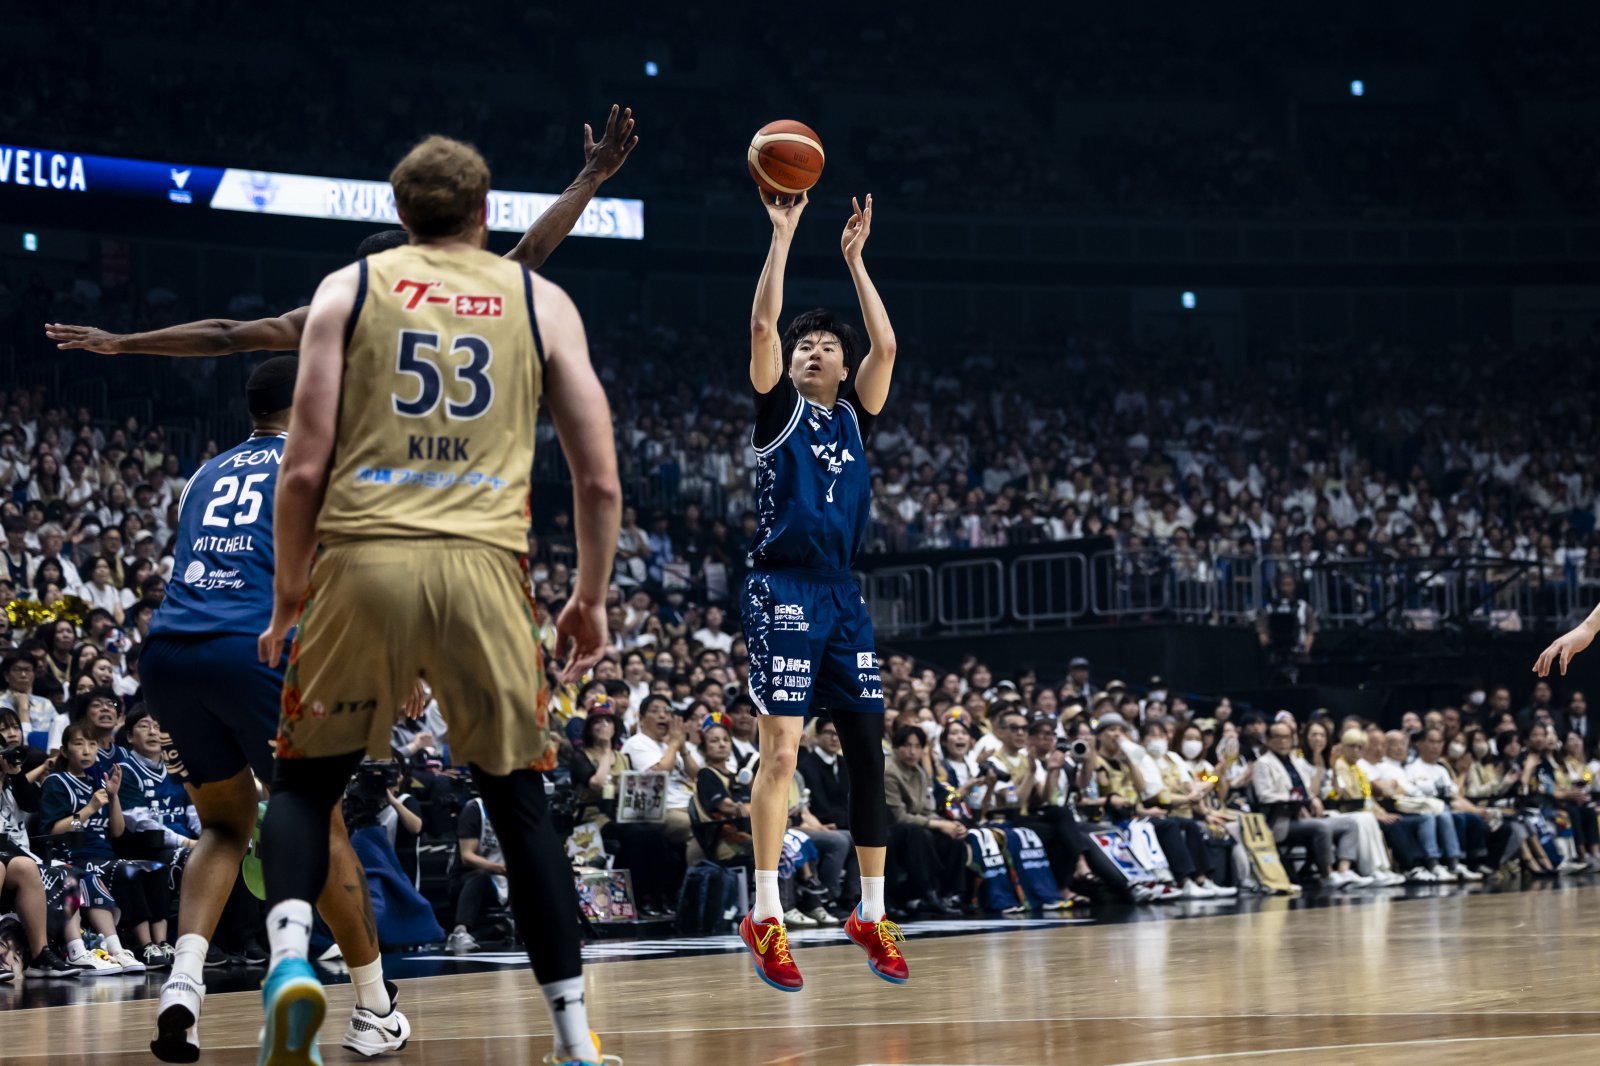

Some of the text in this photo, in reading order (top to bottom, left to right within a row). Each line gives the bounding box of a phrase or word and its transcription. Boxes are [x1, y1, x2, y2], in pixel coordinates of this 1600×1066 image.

[0, 148, 87, 192] VELCA
[326, 181, 399, 222] RYUK
[391, 329, 494, 421] 53
[408, 434, 470, 461] KIRK
[202, 473, 270, 528] 25
[193, 535, 254, 553] MITCHELL
[195, 579, 245, 591] エリエール
[209, 568, 240, 578] elleair
[774, 604, 804, 615] BENEX
